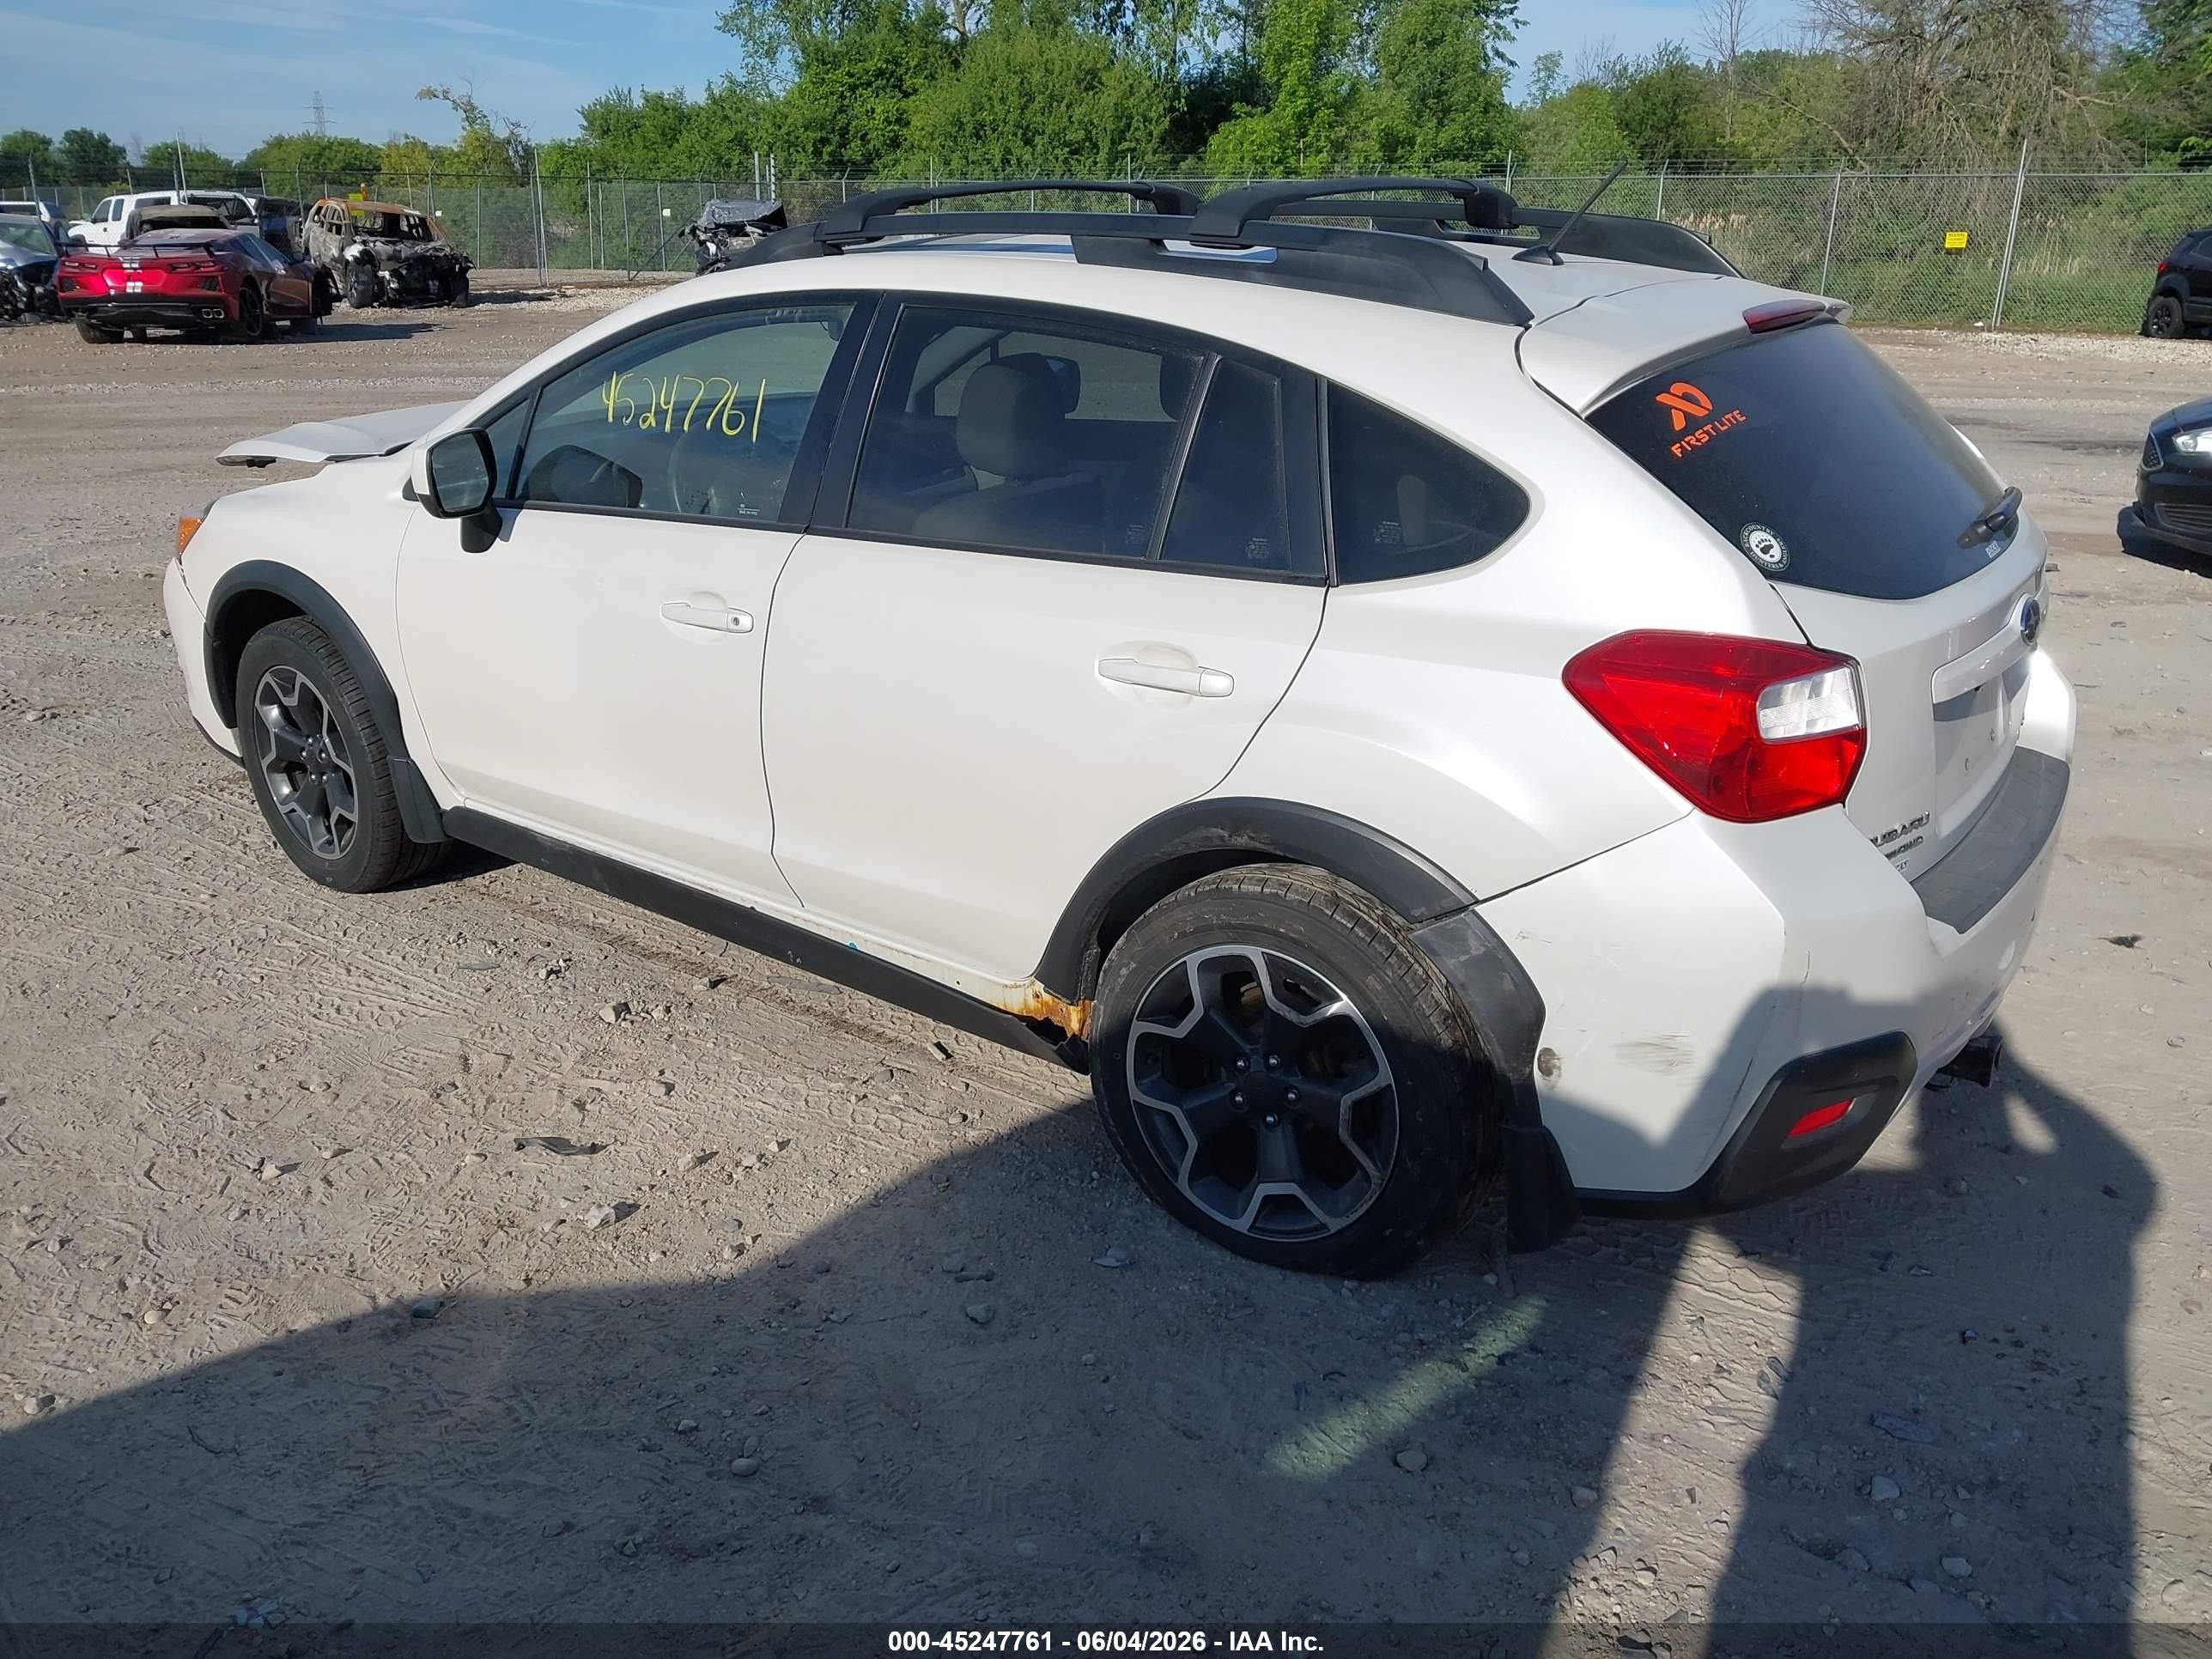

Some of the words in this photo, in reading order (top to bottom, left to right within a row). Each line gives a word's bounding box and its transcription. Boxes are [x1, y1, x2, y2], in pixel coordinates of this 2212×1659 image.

[602, 371, 767, 445] 45247761
[1670, 423, 1717, 458] FIRST
[1714, 410, 1747, 432] LITE
